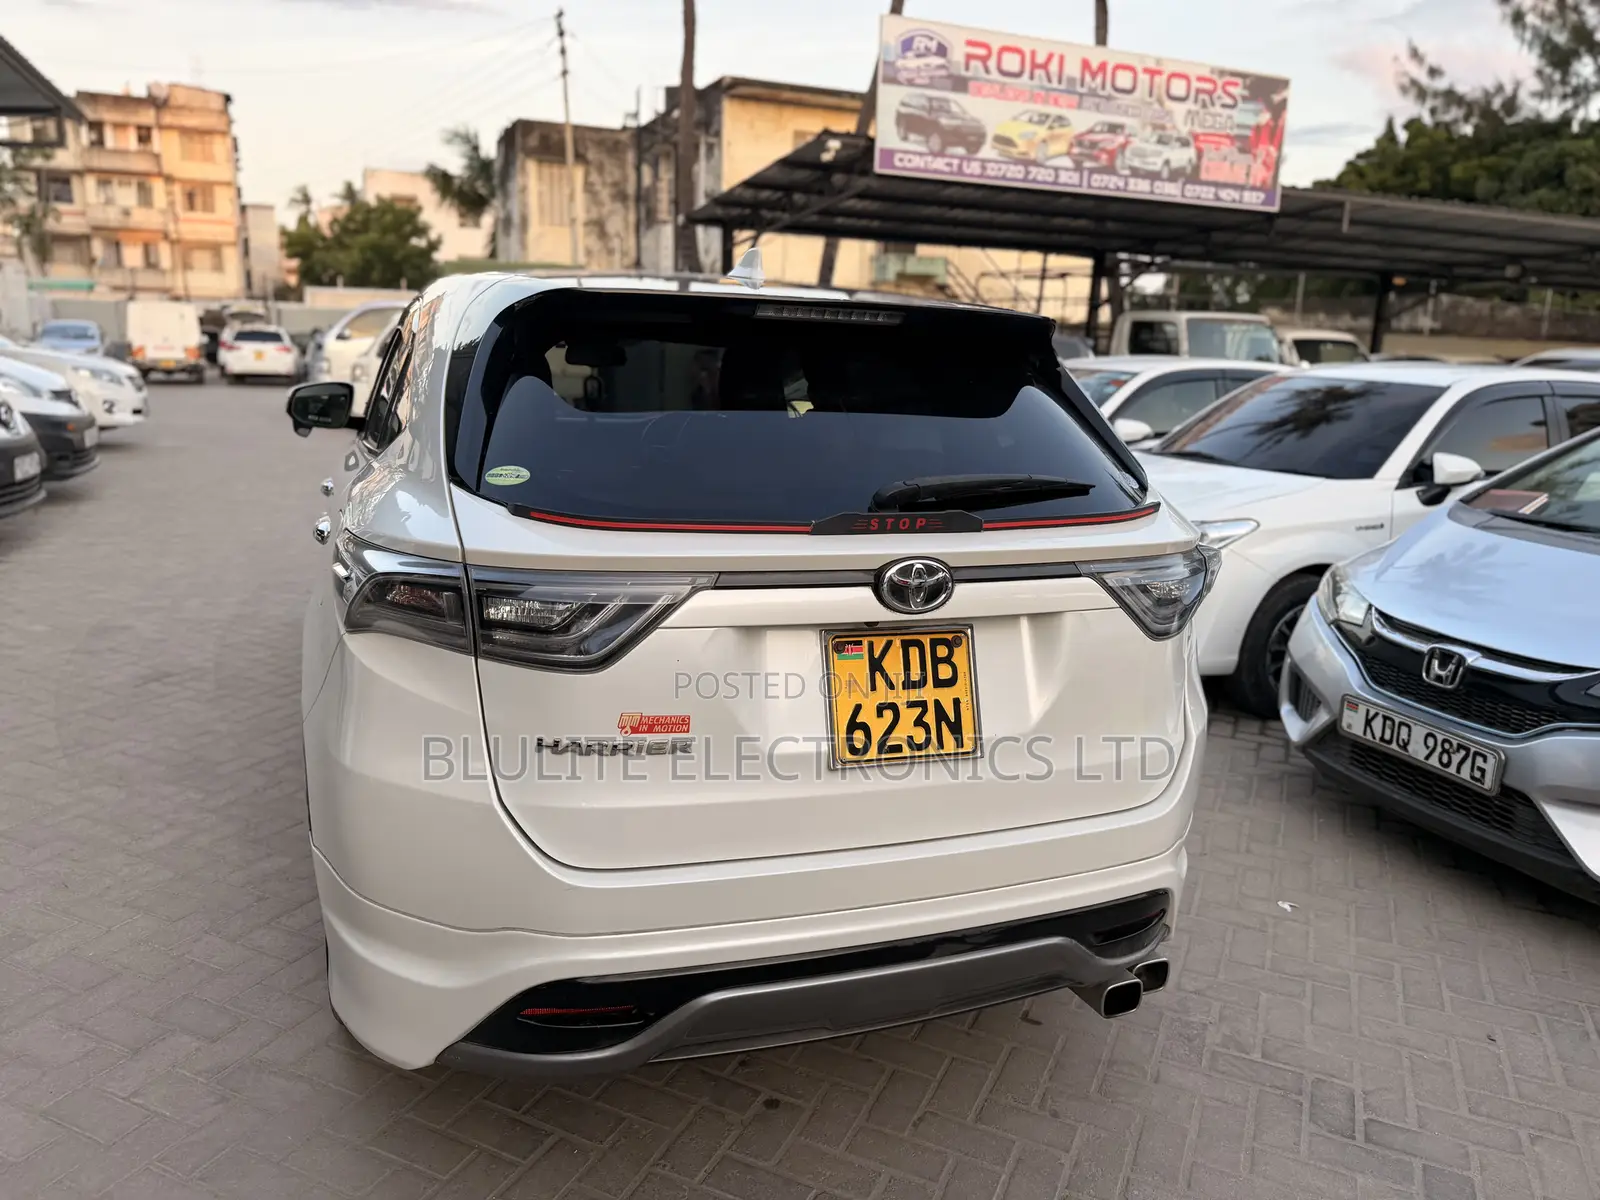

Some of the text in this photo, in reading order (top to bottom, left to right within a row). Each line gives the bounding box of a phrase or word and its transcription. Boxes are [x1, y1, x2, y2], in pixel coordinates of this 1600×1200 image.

[964, 39, 1065, 86] ROKI
[1080, 57, 1241, 110] MOTORS
[893, 152, 960, 174] CONTACT
[962, 160, 982, 175] US
[869, 518, 927, 531] STOP
[866, 637, 959, 692] KDB
[638, 724, 689, 733] IN MOTION
[639, 715, 690, 724] MECHANICS
[845, 697, 964, 757] 623N
[535, 736, 694, 757] HARRIER
[1363, 707, 1488, 786] KDQ 987G
